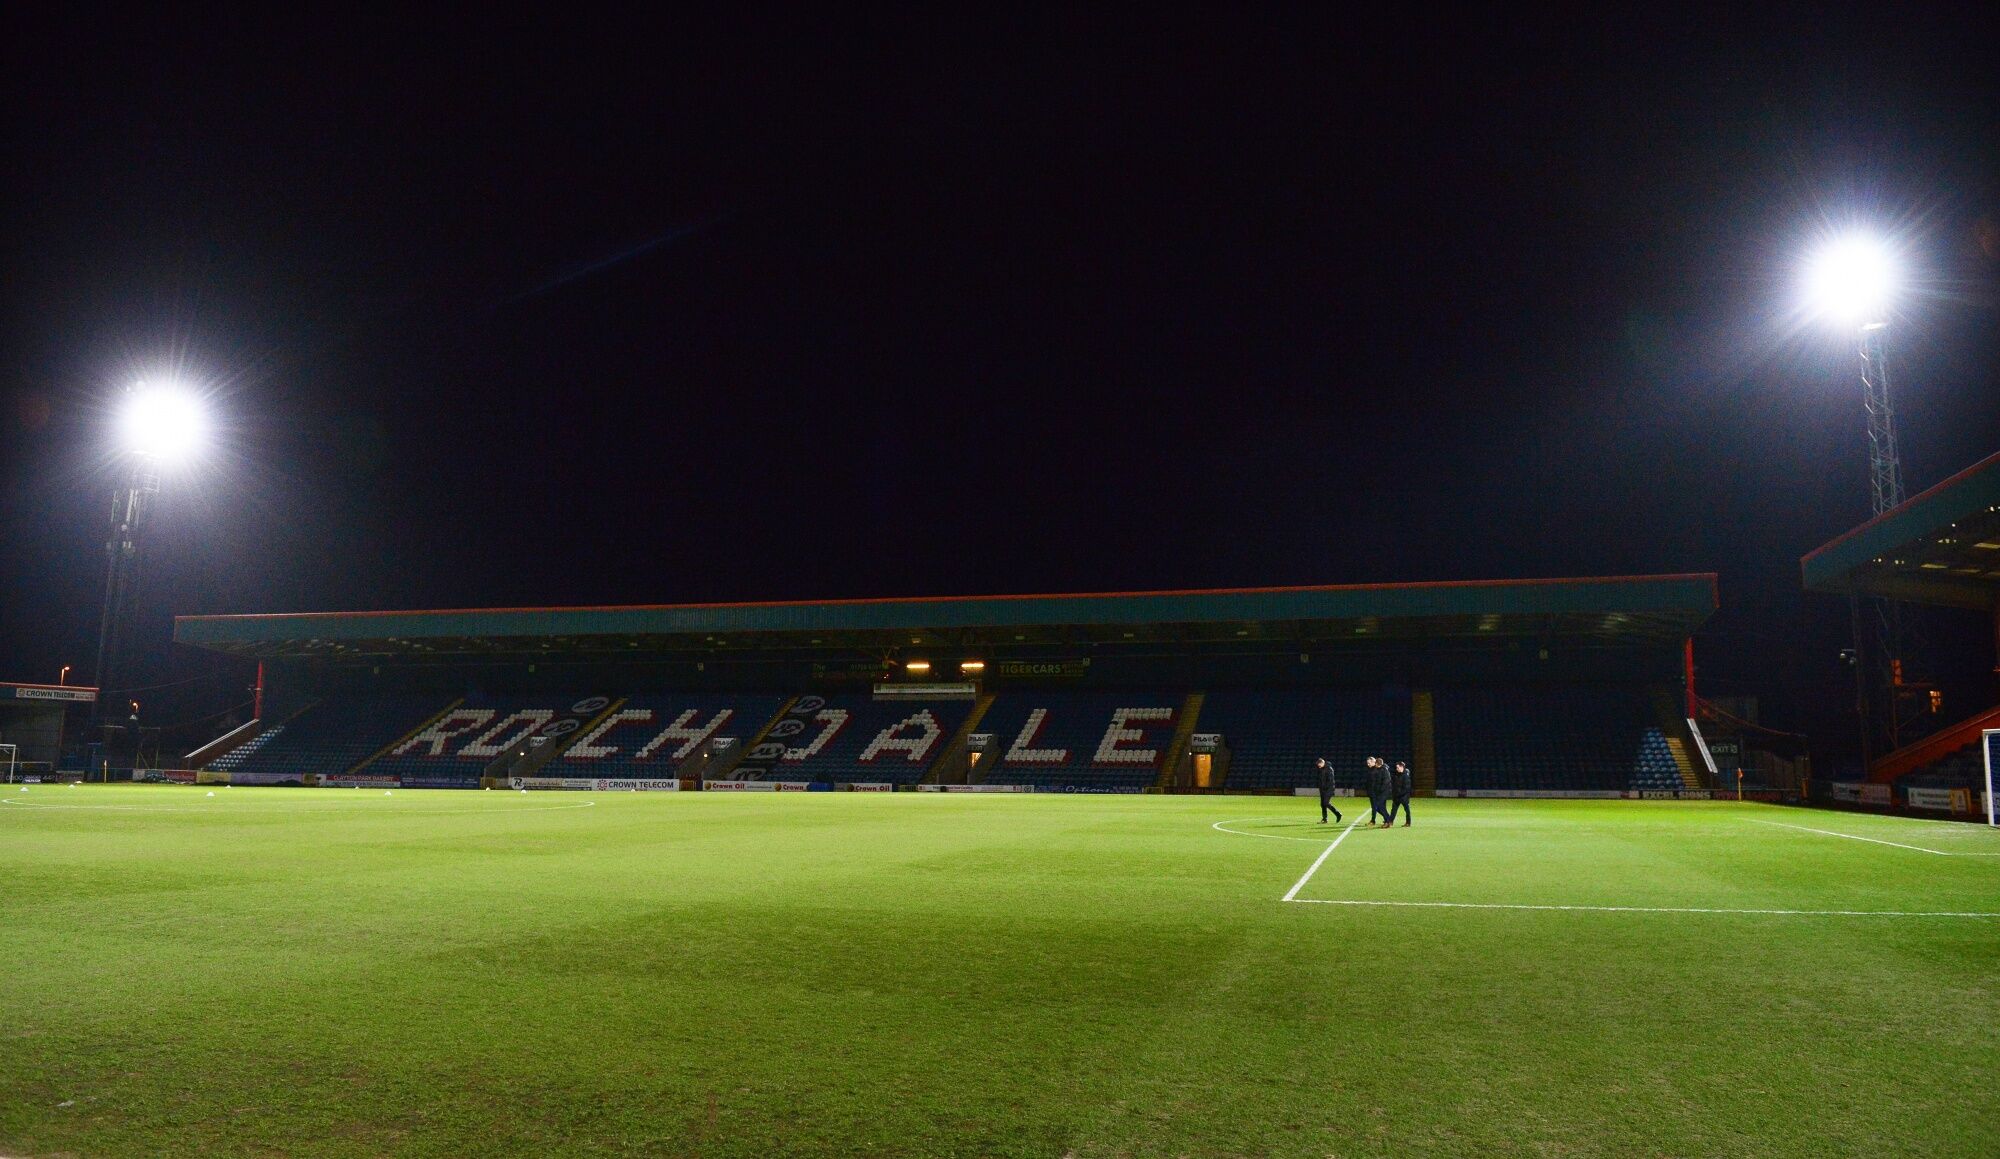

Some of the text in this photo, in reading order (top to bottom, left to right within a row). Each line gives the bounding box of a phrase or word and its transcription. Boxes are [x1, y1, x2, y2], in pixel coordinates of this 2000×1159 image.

[1711, 745, 1728, 753] EXIT
[639, 781, 674, 789] TELECOM
[1642, 790, 1676, 799] EXCEL
